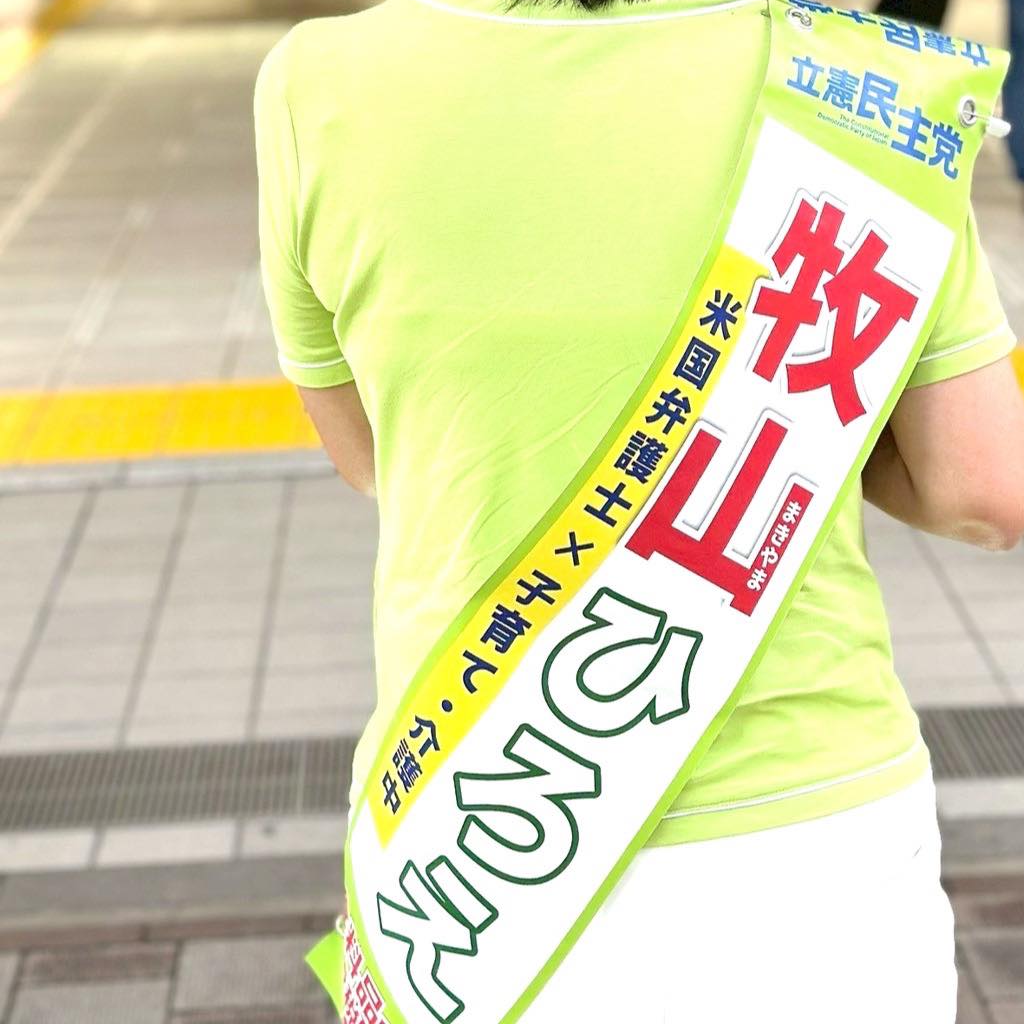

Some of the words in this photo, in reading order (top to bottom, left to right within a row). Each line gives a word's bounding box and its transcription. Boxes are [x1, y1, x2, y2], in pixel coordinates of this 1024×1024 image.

[787, 55, 963, 180] 立憲民主党
[746, 501, 802, 592] まきやま
